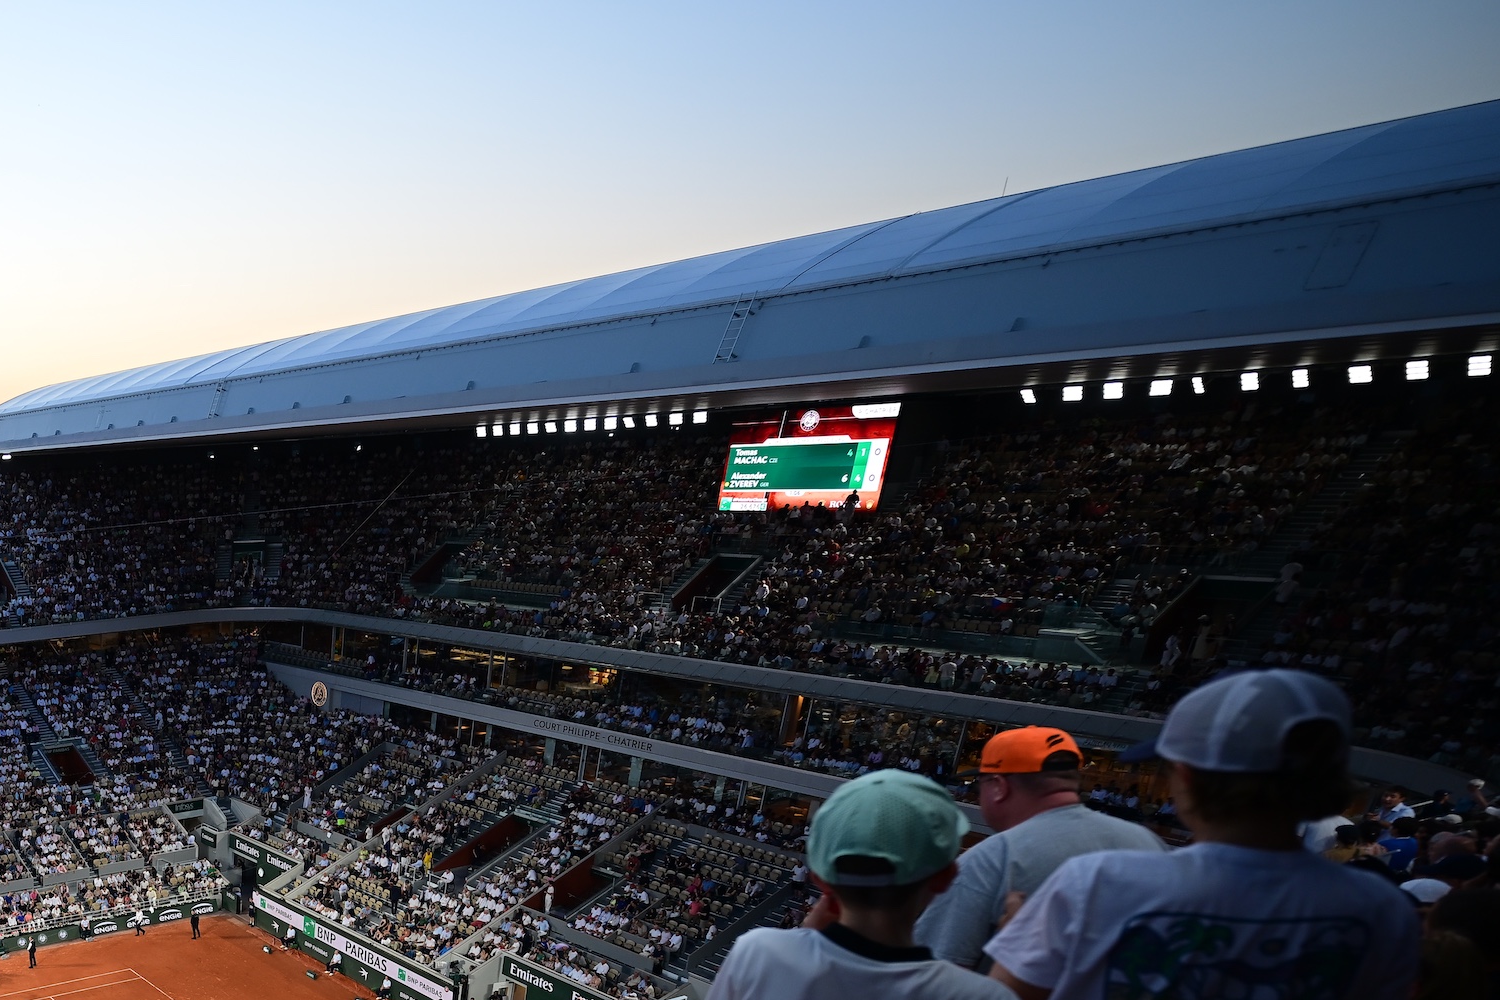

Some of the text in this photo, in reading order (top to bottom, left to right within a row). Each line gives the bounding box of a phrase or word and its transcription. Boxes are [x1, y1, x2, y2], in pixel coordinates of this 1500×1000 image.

[735, 448, 758, 456] Tomas
[847, 449, 853, 457] 4
[861, 448, 866, 456] 1
[734, 456, 768, 464] MACHAC
[731, 472, 767, 480] Alexander
[841, 474, 848, 482] 6
[854, 474, 861, 482] 4
[729, 480, 759, 488] ZVEREV
[534, 720, 560, 730] COURT
[563, 725, 600, 740] PHILIPPE
[607, 735, 653, 752] CHATRIER
[235, 839, 260, 858] Emirates
[317, 927, 387, 972] BNP PARIBAS
[510, 963, 554, 993] Emirates
[419, 982, 442, 998] PARIBAS
